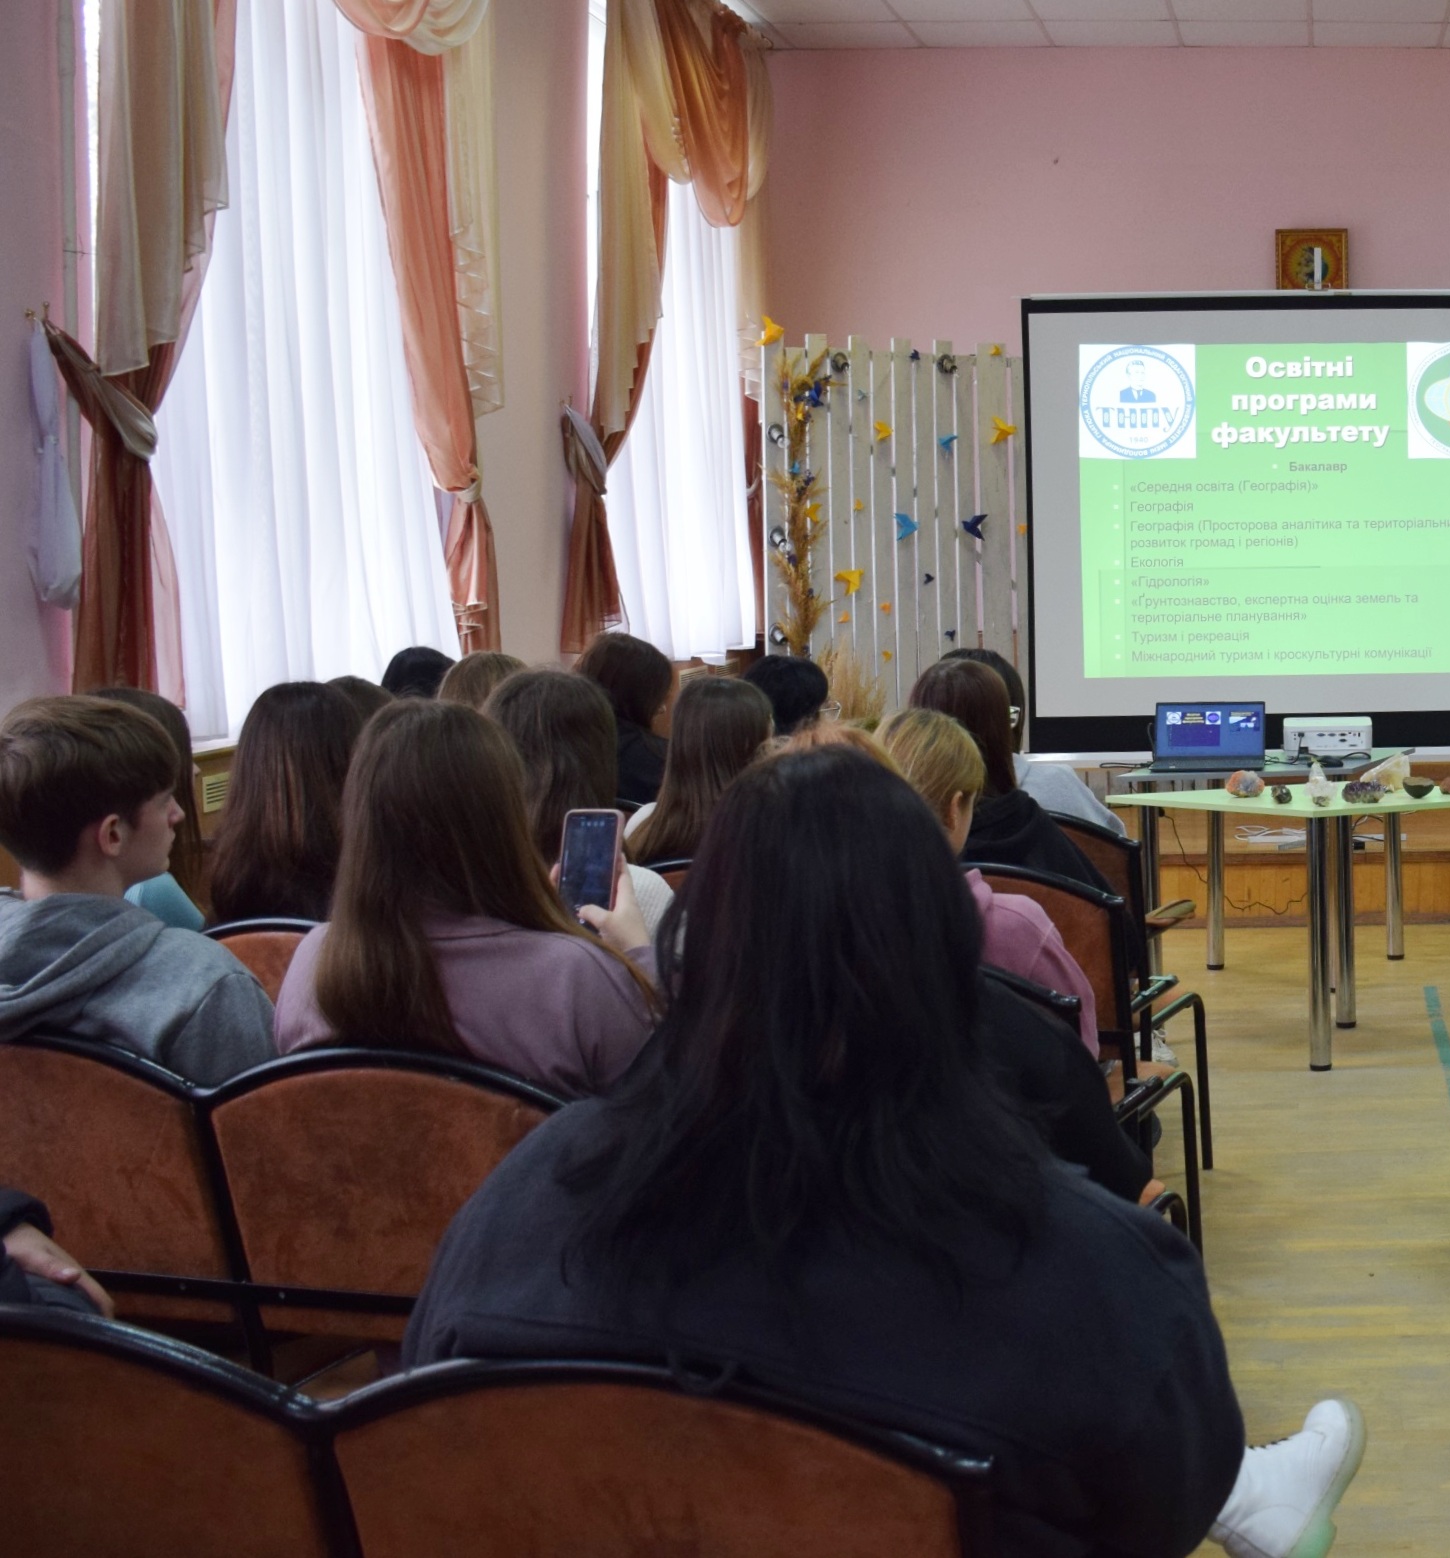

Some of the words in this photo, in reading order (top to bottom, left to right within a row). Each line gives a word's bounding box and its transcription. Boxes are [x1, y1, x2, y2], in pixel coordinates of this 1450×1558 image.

[1246, 356, 1354, 379] Освітні
[1231, 393, 1378, 416] програми
[1096, 407, 1180, 433] ТНПУ
[1211, 421, 1390, 449] факультету
[1289, 461, 1348, 474] Бакалавр
[1130, 481, 1193, 495] «Середня
[1196, 481, 1235, 492] освіта
[1238, 480, 1319, 494] (Географія)»
[1130, 501, 1194, 514] Географія
[1130, 520, 1194, 533] Географія
[1198, 519, 1278, 533] (Просторова
[1282, 519, 1342, 530] аналітика
[1346, 519, 1360, 530] та
[1130, 538, 1187, 551] розвиток
[1190, 538, 1235, 550] громад
[1245, 536, 1299, 549] регіонів)
[1130, 557, 1184, 569] Екологія
[1131, 576, 1210, 589] «Гідрологія»
[1131, 593, 1241, 607] «Ґрунтознавство,
[1245, 596, 1309, 606] експертна
[1312, 594, 1351, 606] оцінка
[1355, 594, 1401, 604] земель
[1405, 593, 1419, 604] та
[1131, 612, 1223, 624] територіальне
[1226, 611, 1307, 624] планування»
[1131, 631, 1178, 644] Туризм
[1188, 630, 1250, 644] рекреація
[1131, 650, 1216, 663] Міжнародний
[1220, 651, 1264, 662] туризм
[1274, 648, 1361, 662] кроскультурні
[1364, 646, 1433, 661] комунікації
